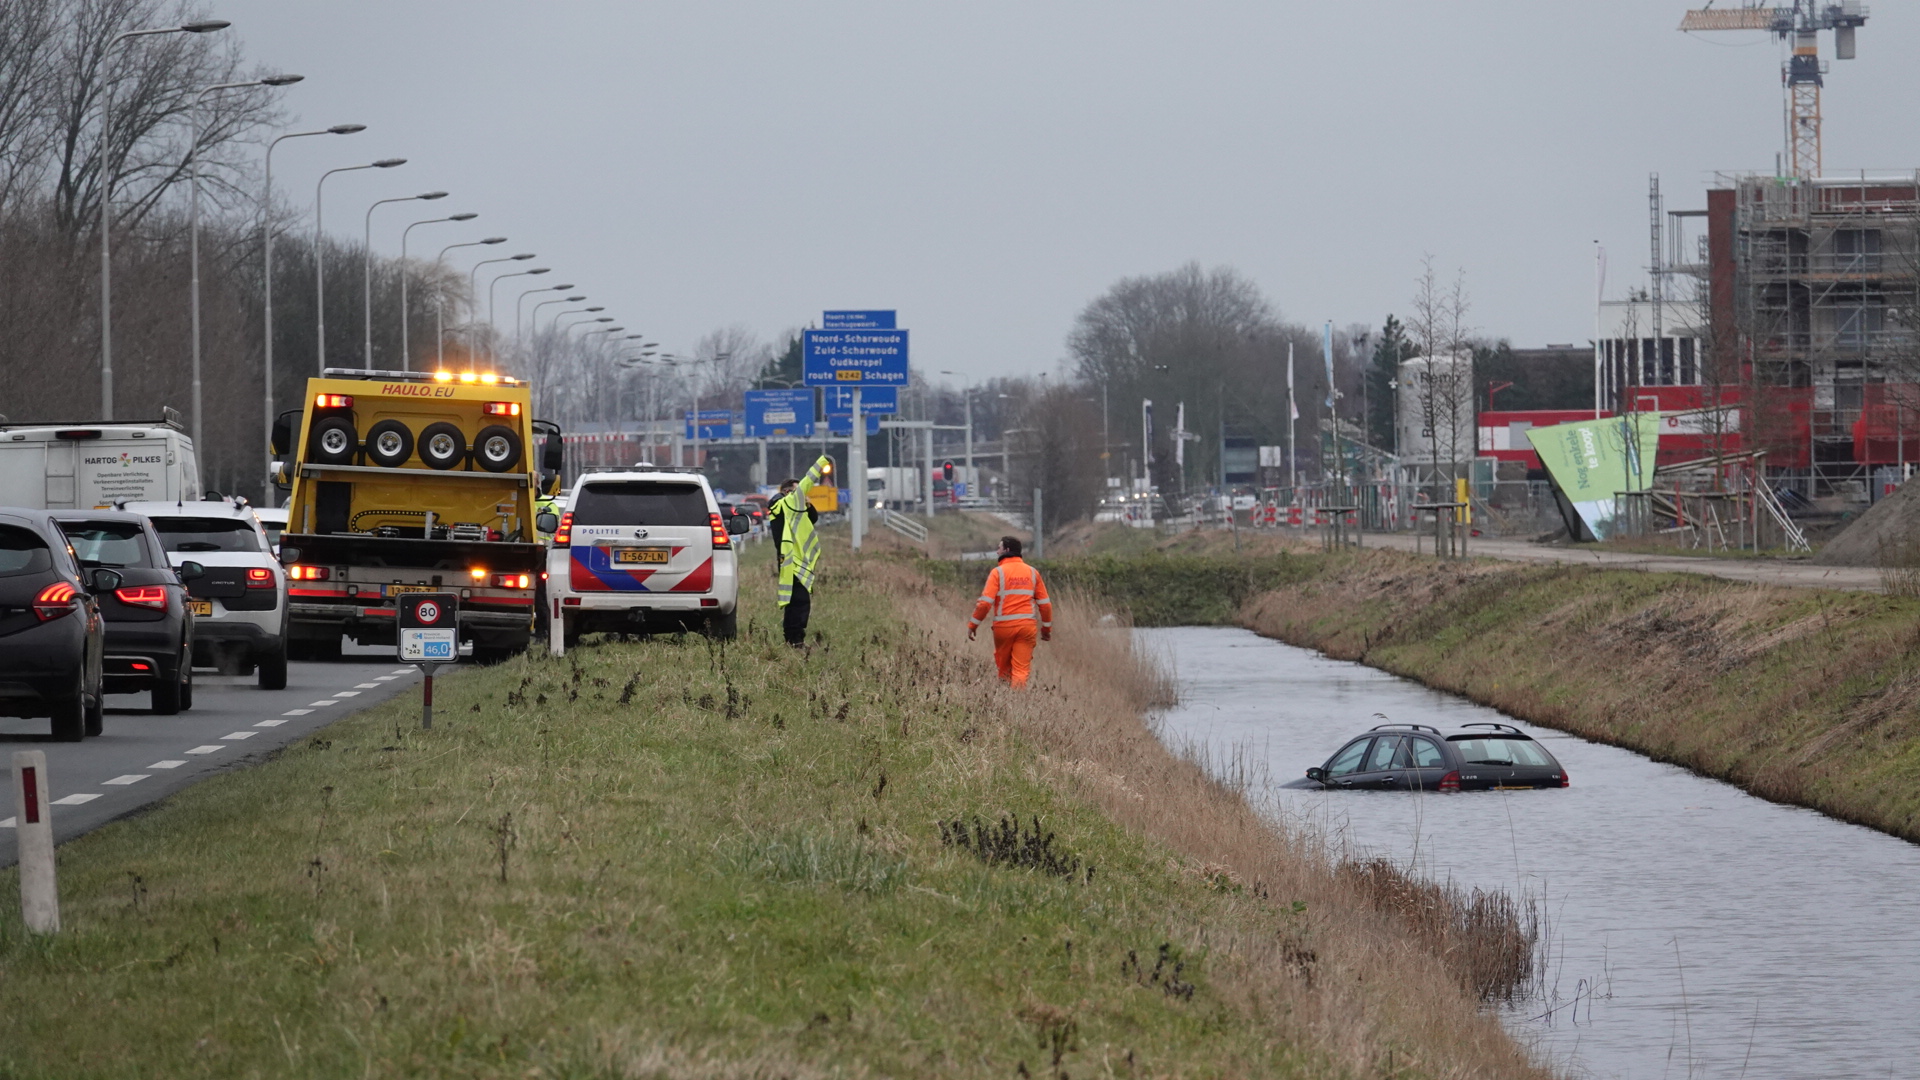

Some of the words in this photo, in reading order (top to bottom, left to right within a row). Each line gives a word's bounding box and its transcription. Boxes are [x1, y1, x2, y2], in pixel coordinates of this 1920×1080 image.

[811, 334, 901, 343] Noord-Scharwoude
[814, 346, 898, 355] Zuid-Scharwoude
[829, 358, 882, 367] Oudkarspel
[808, 372, 833, 380] route
[864, 371, 904, 382] Schagen
[1566, 429, 1584, 466] enkele
[1588, 456, 1599, 469] te
[1577, 466, 1590, 490] Nog
[420, 608, 436, 617] 80
[425, 643, 448, 655] 46,0
